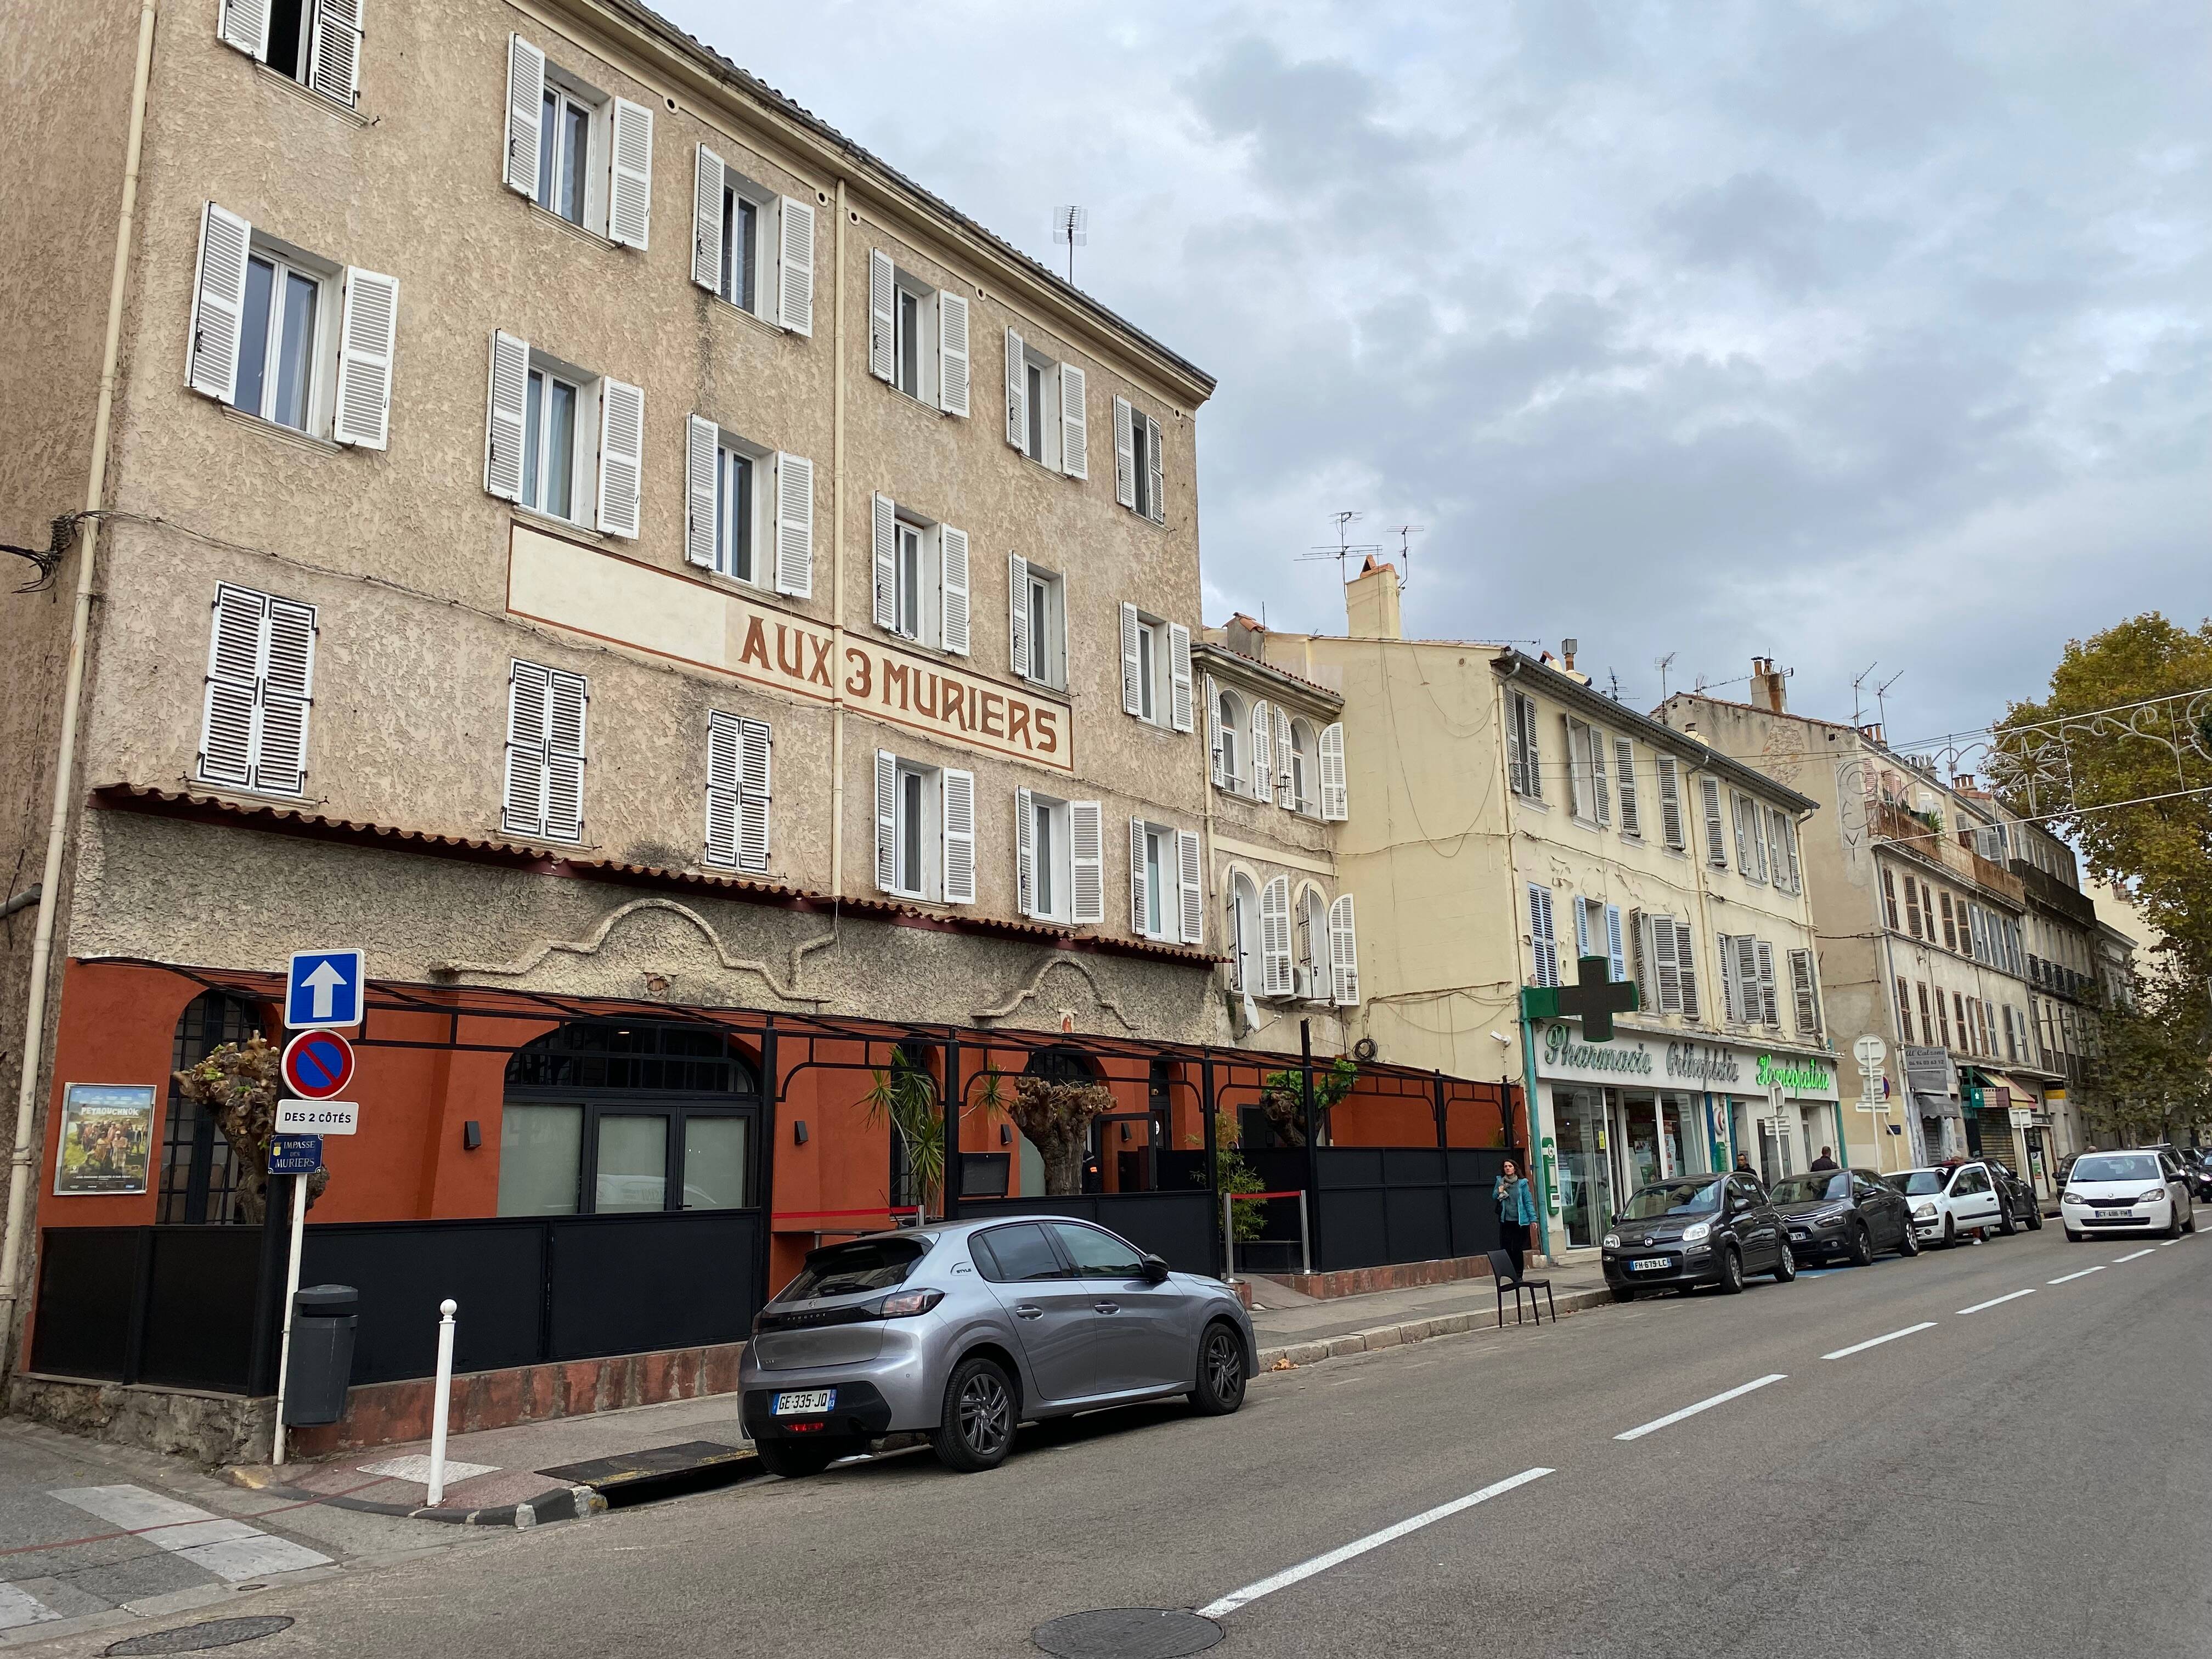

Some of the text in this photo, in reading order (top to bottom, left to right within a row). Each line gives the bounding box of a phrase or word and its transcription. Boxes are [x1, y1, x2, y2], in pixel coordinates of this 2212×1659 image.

[738, 614, 1057, 753] AUX 3 MURIERS
[1544, 1024, 1652, 1074] Pharmacie
[285, 1112, 351, 1123] DES 2 CÔTÉS
[284, 1141, 316, 1149] IMPASSE
[275, 1158, 315, 1168] MURIERS
